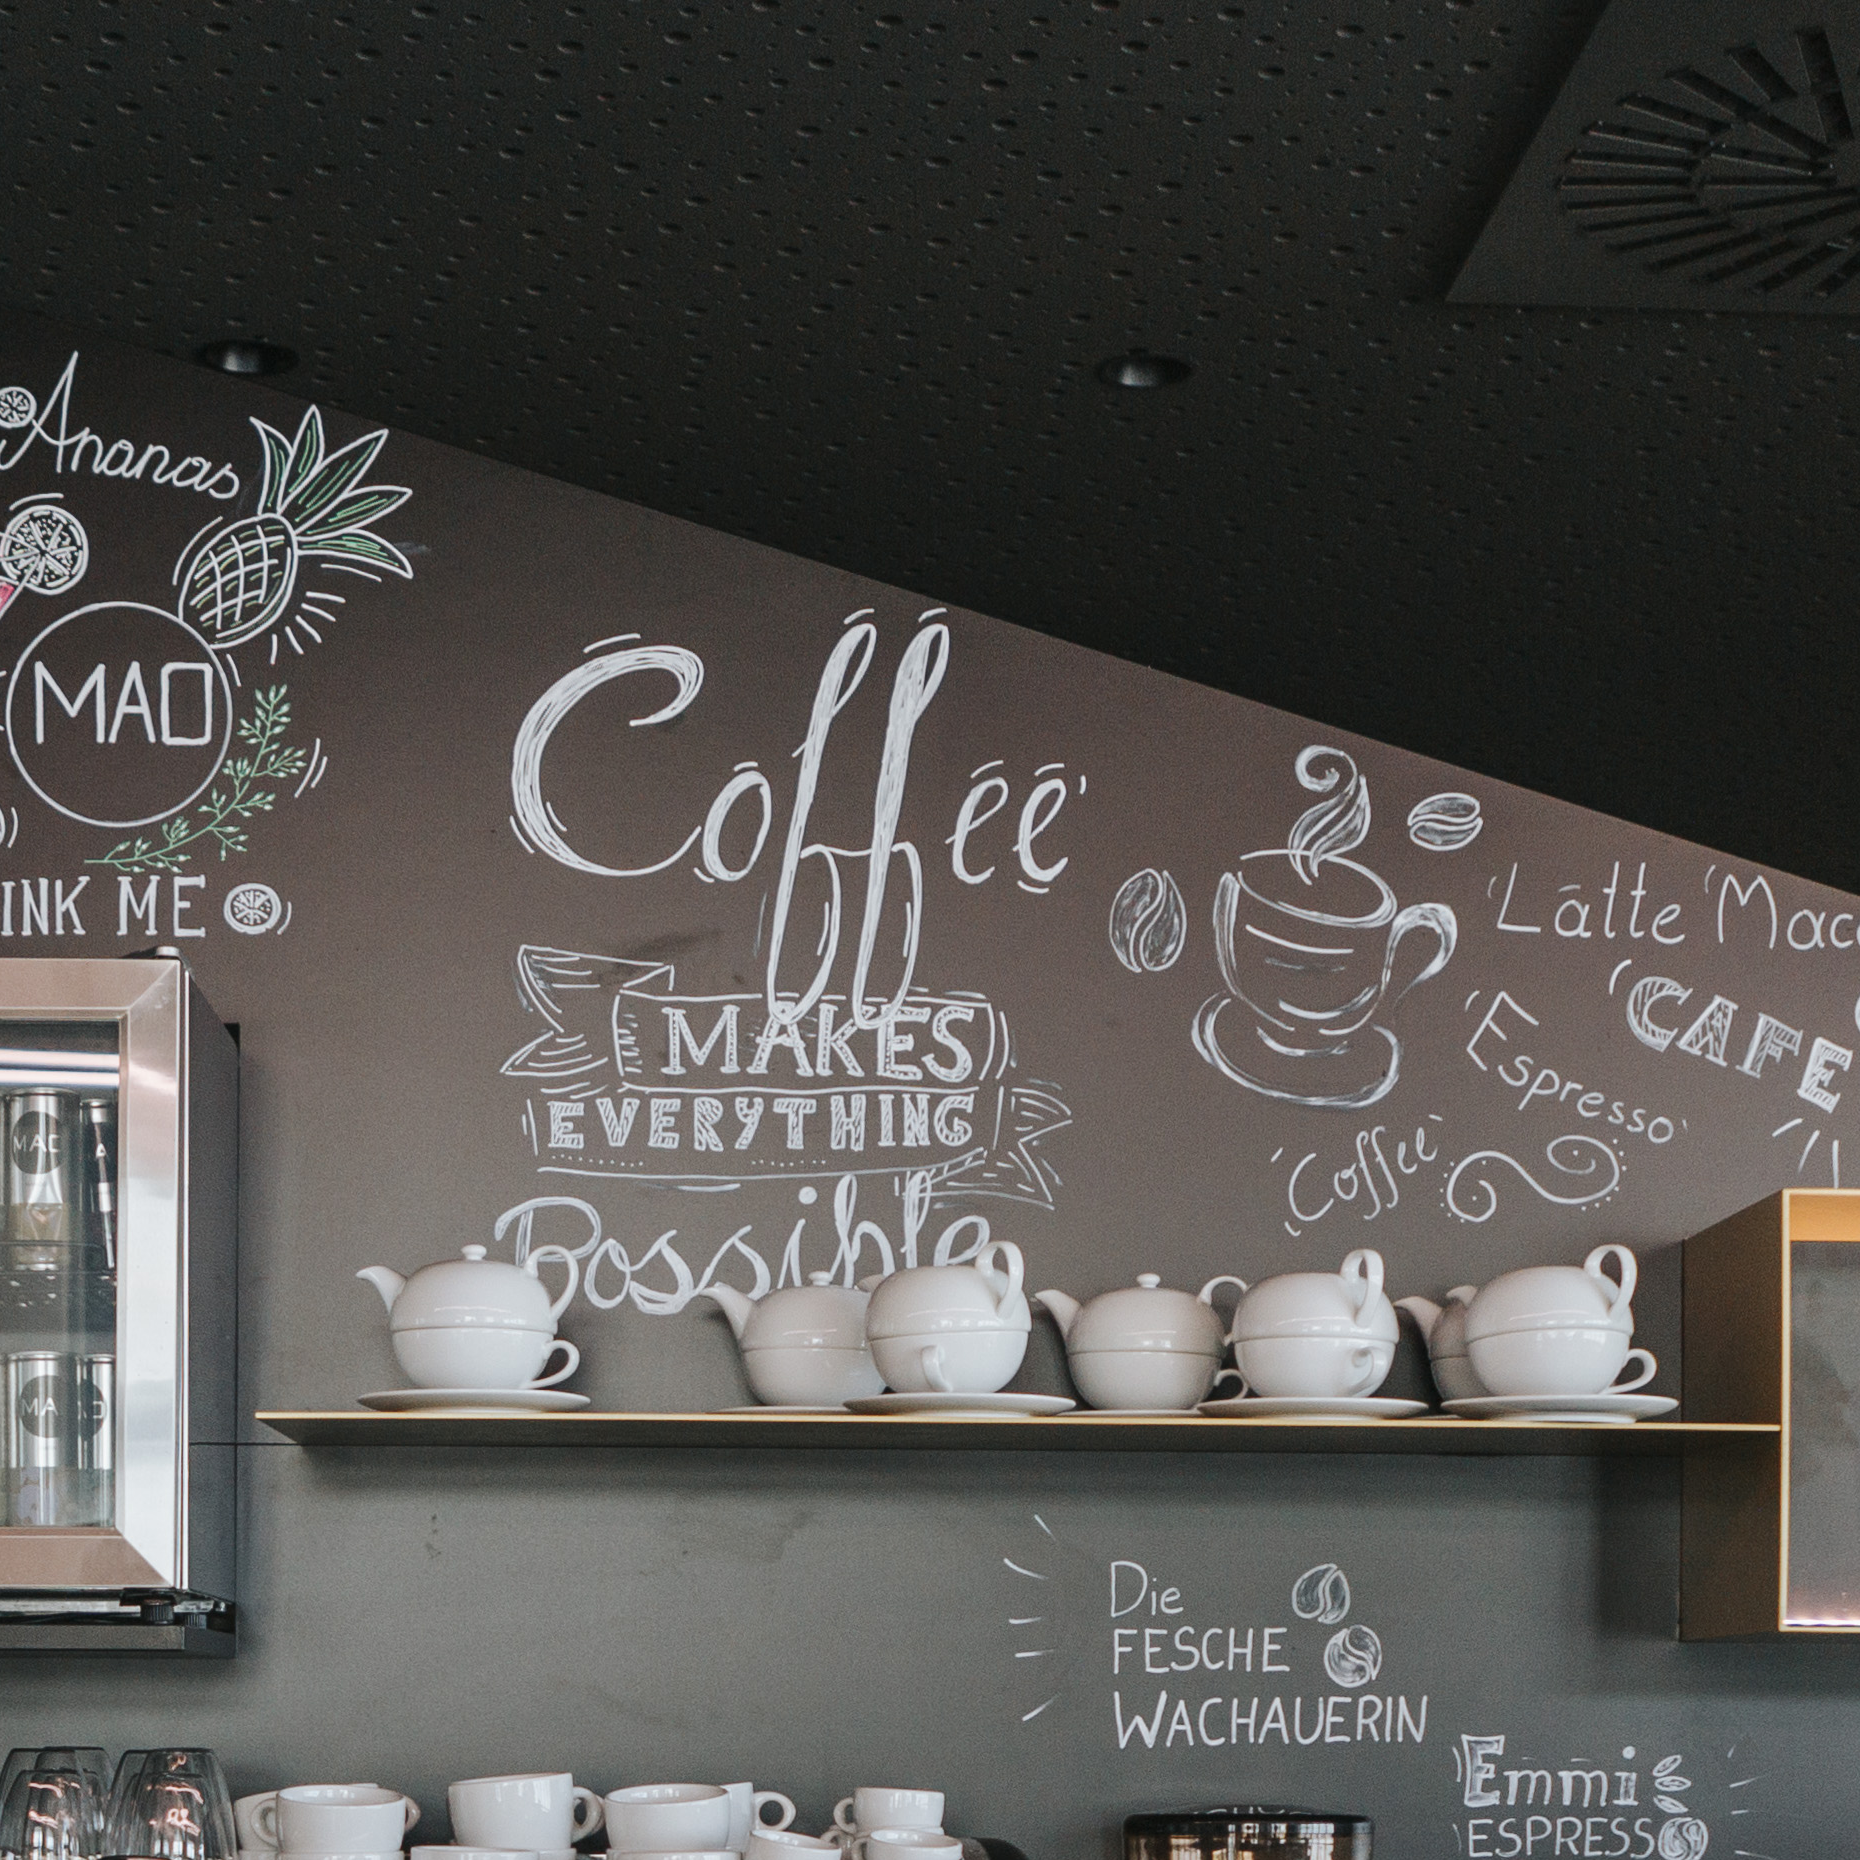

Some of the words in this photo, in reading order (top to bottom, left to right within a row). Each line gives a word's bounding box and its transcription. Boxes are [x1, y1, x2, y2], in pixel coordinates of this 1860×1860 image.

[511, 620, 1071, 1030] Coffee
[117, 874, 207, 939] ME
[1496, 860, 1687, 944] Latte
[660, 1004, 991, 1084] MAKES
[1465, 988, 1677, 1146] Espresso
[1624, 974, 1853, 1113] CAFE
[547, 1092, 976, 1151] EVERYTHING
[1285, 1122, 1441, 1223] Coffee
[1108, 1560, 1185, 1618] Die
[1113, 1626, 1291, 1676] FESCHE
[1113, 1690, 1429, 1749] WACHAUERIN
[1460, 1734, 1641, 1808] Emmi
